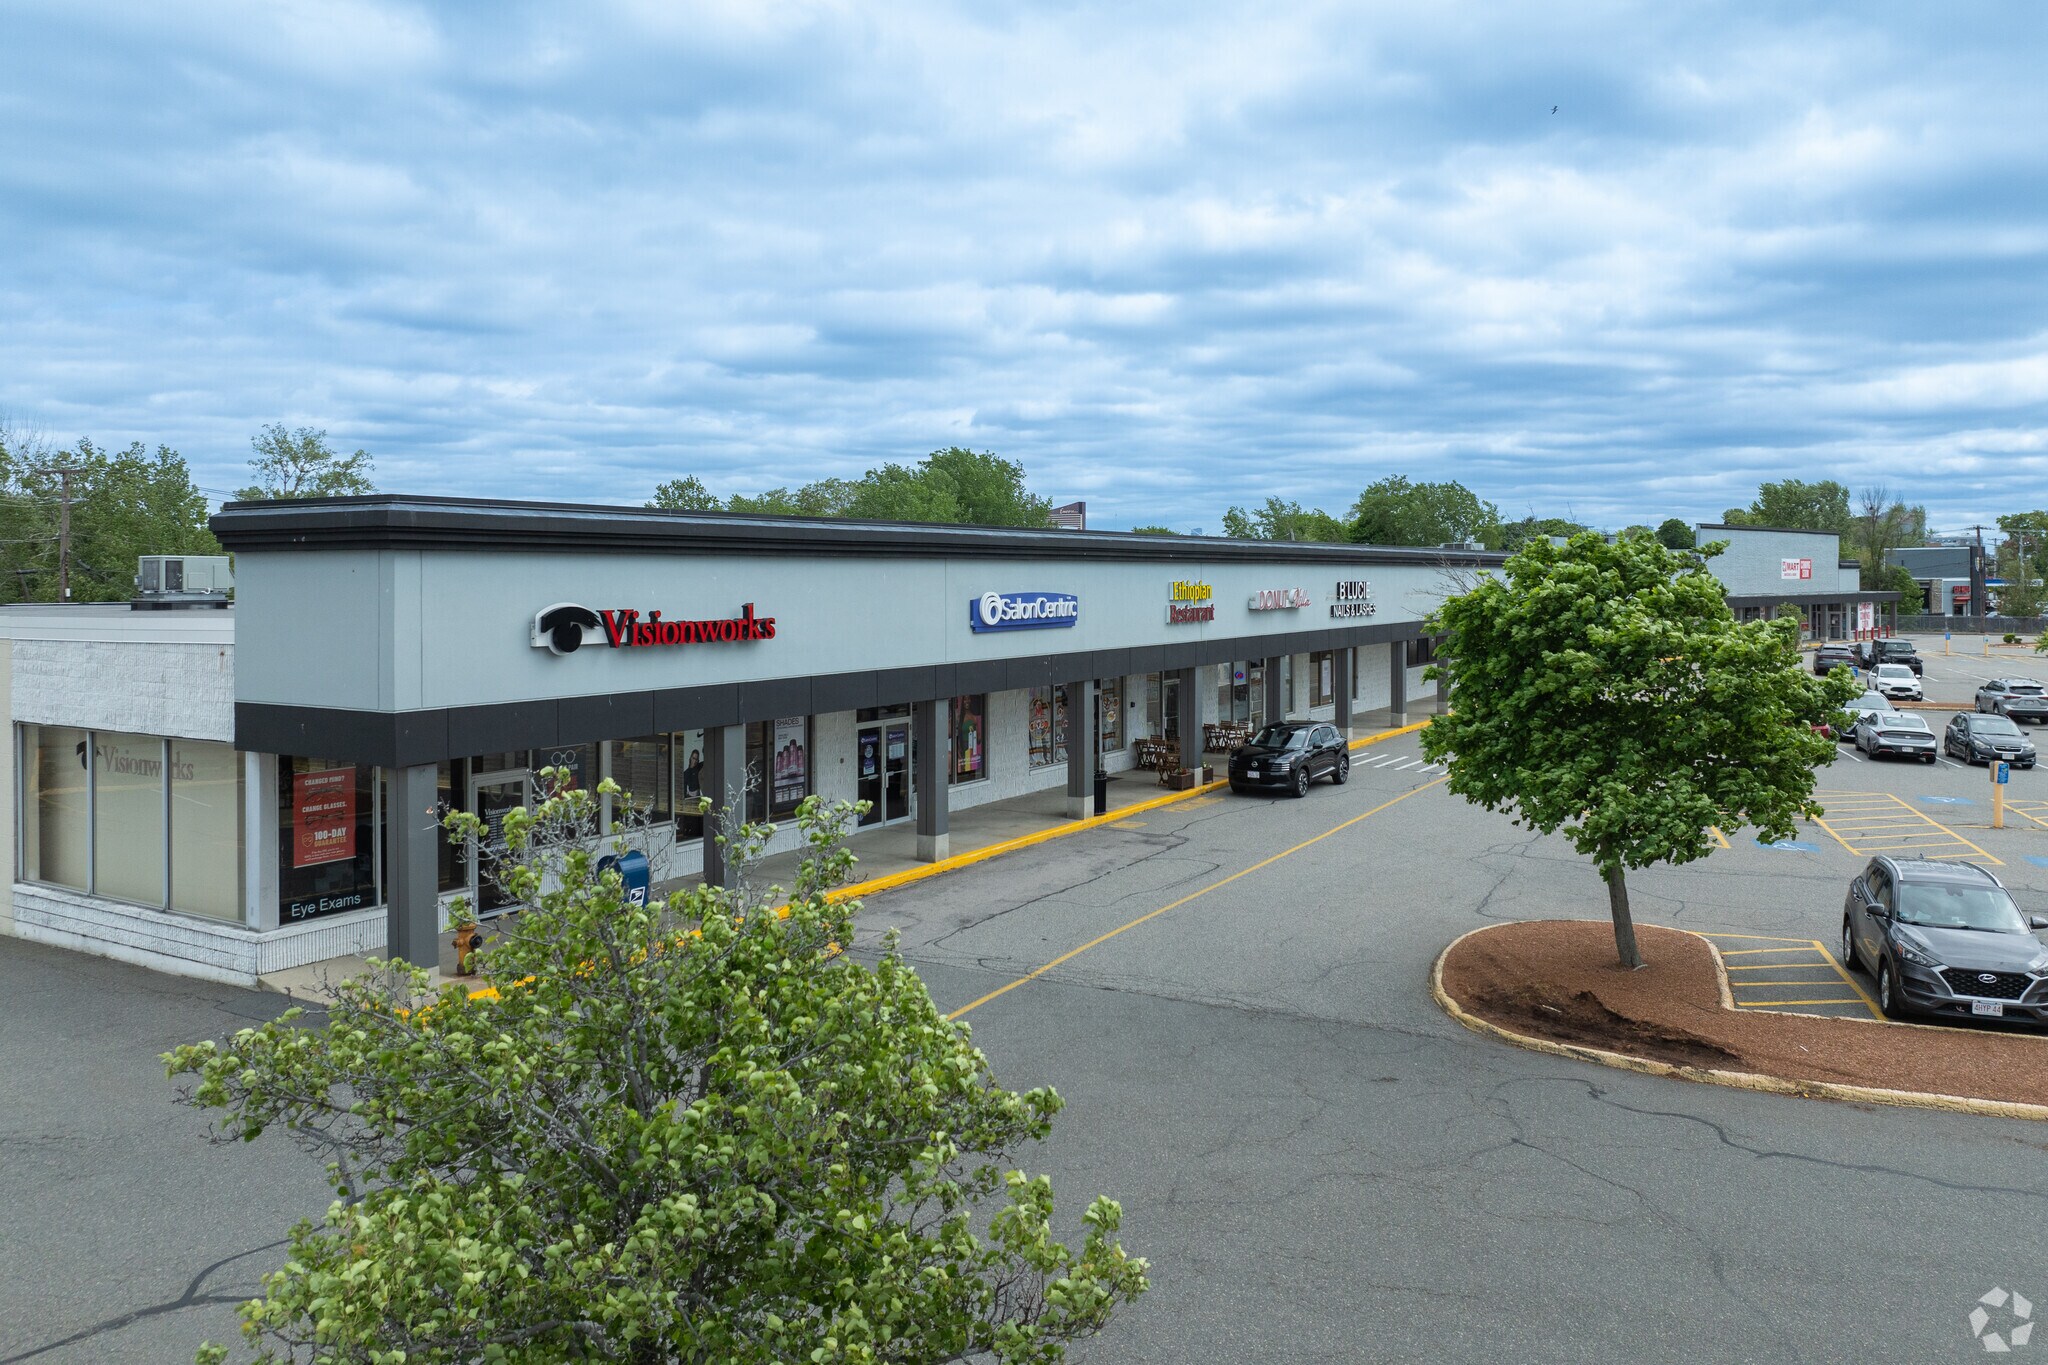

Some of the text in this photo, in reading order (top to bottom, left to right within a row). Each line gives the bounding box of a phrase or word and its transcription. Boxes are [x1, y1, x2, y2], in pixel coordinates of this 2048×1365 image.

[1173, 581, 1212, 605] Ethiopian
[1259, 590, 1288, 610] DONUT
[1001, 597, 1078, 621] SalonCentric
[1169, 604, 1215, 623] Restaurant
[1333, 603, 1376, 617] NAILS & LASHES
[599, 602, 776, 648] Visionworks
[776, 718, 799, 727] SHADES
[101, 744, 194, 781] Visionwrks
[304, 777, 329, 786] CHANGED
[302, 801, 347, 813] CHANGE GLASSES.
[314, 827, 347, 840] 100-DAY
[314, 836, 347, 847] GUARANTEE
[291, 894, 361, 919] Eye Exams
